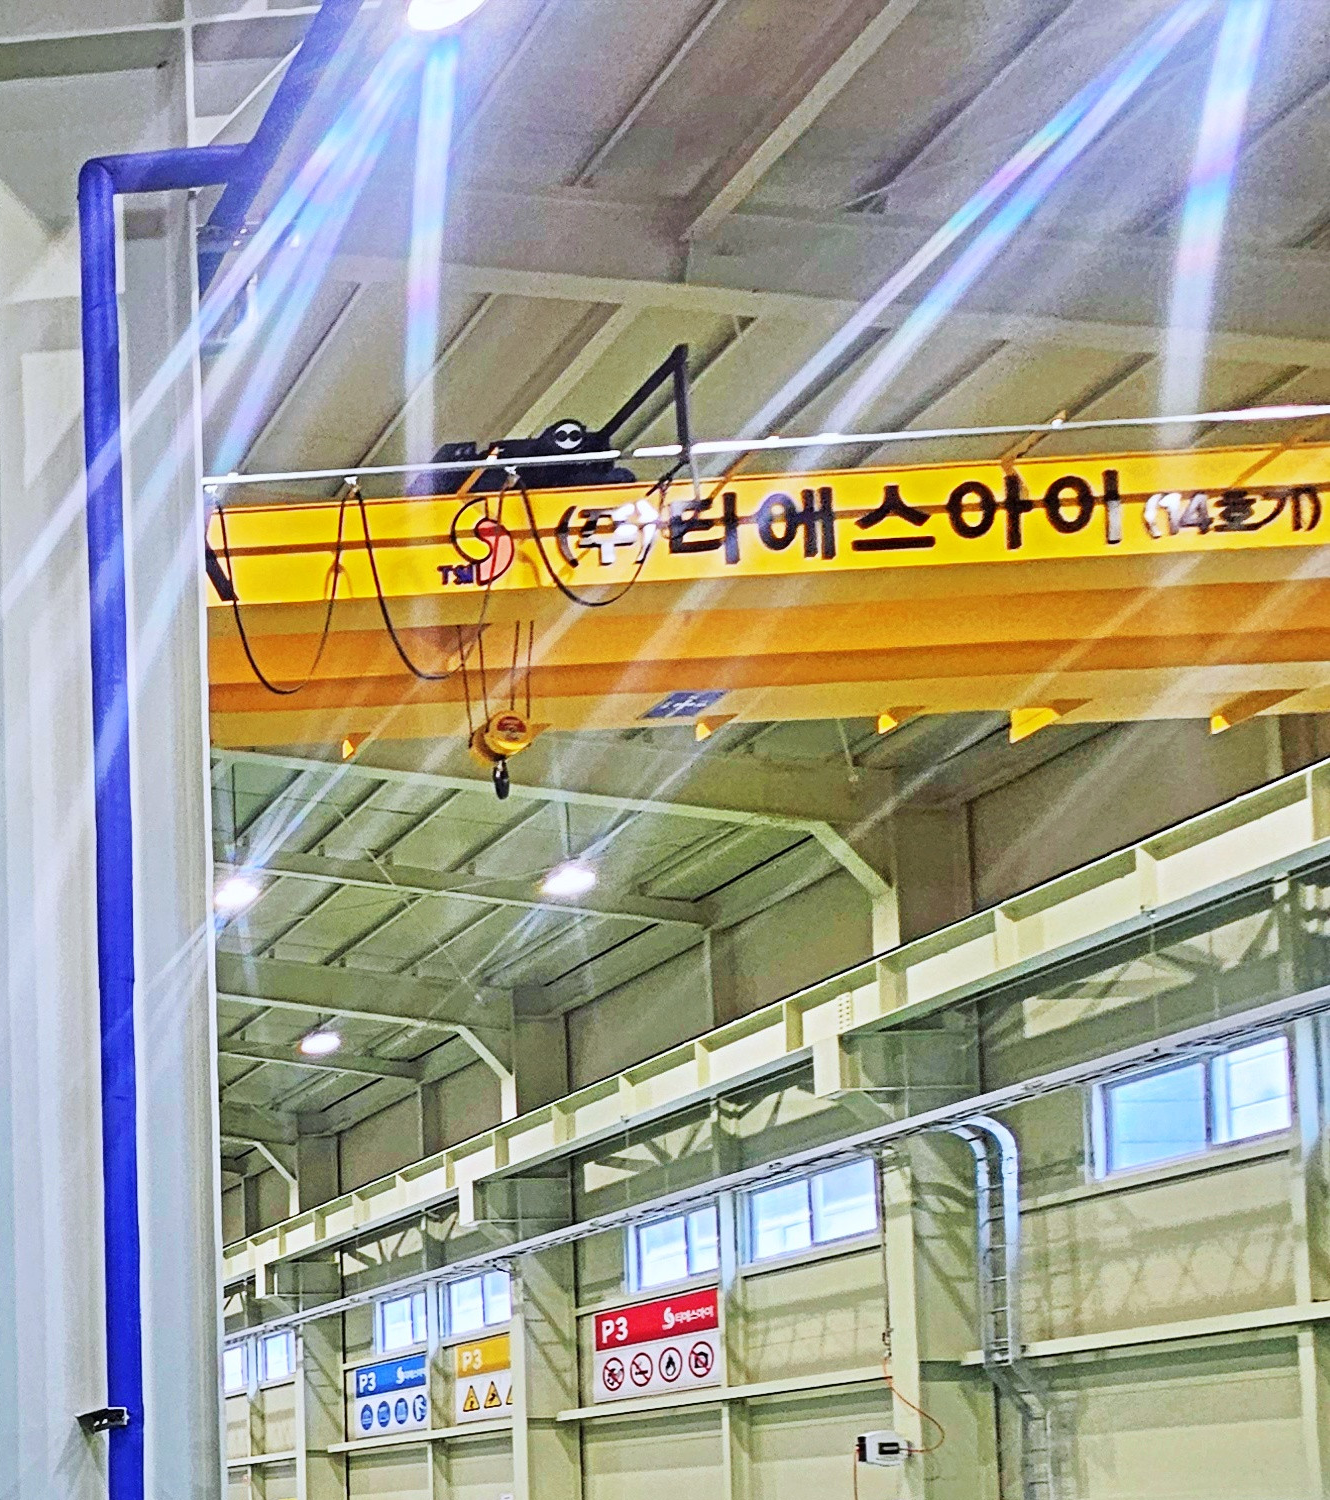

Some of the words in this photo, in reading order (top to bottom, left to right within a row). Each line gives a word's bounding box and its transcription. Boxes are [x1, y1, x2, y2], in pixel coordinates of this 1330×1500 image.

[1143, 484, 1322, 538] (14호기)
[601, 1316, 629, 1344] P3
[461, 1348, 484, 1372] P3
[358, 1371, 377, 1394] P3
